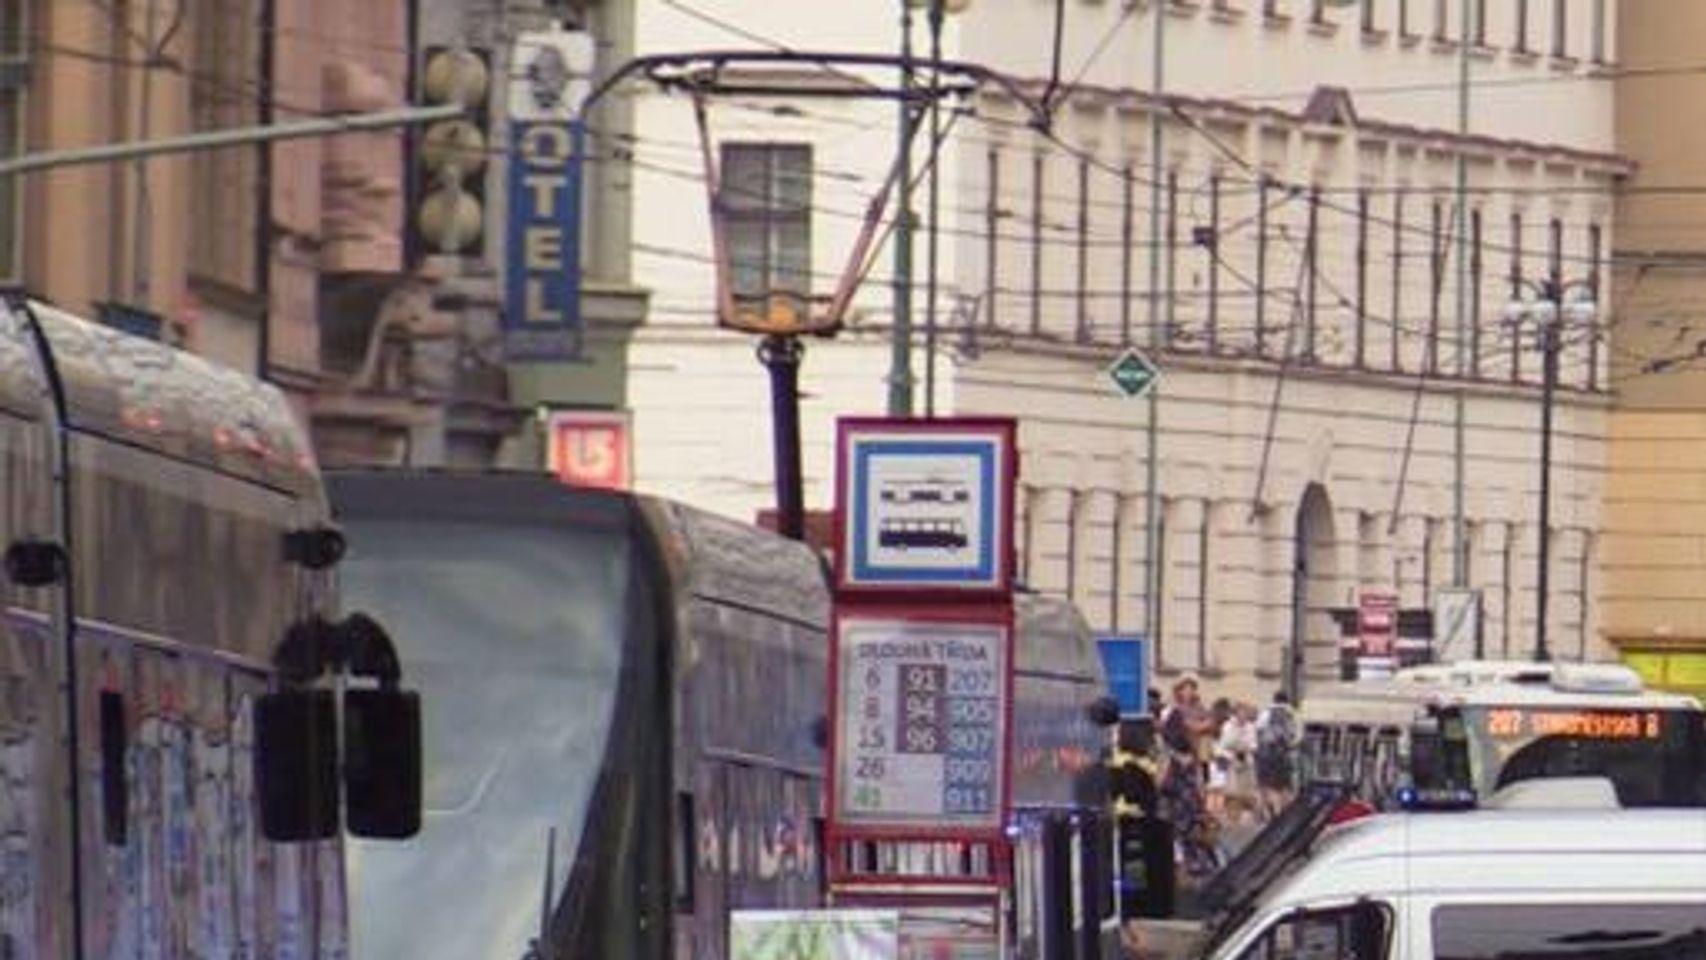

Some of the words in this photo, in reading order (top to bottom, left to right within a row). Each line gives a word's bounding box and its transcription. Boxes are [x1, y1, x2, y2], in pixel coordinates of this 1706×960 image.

[520, 127, 571, 323] OTEL
[908, 666, 936, 690] 91
[951, 670, 991, 693] 207
[908, 699, 936, 722] 94
[1488, 709, 1522, 735] 207
[858, 725, 884, 748] 15
[908, 727, 936, 750] 96
[948, 788, 990, 811] 911
